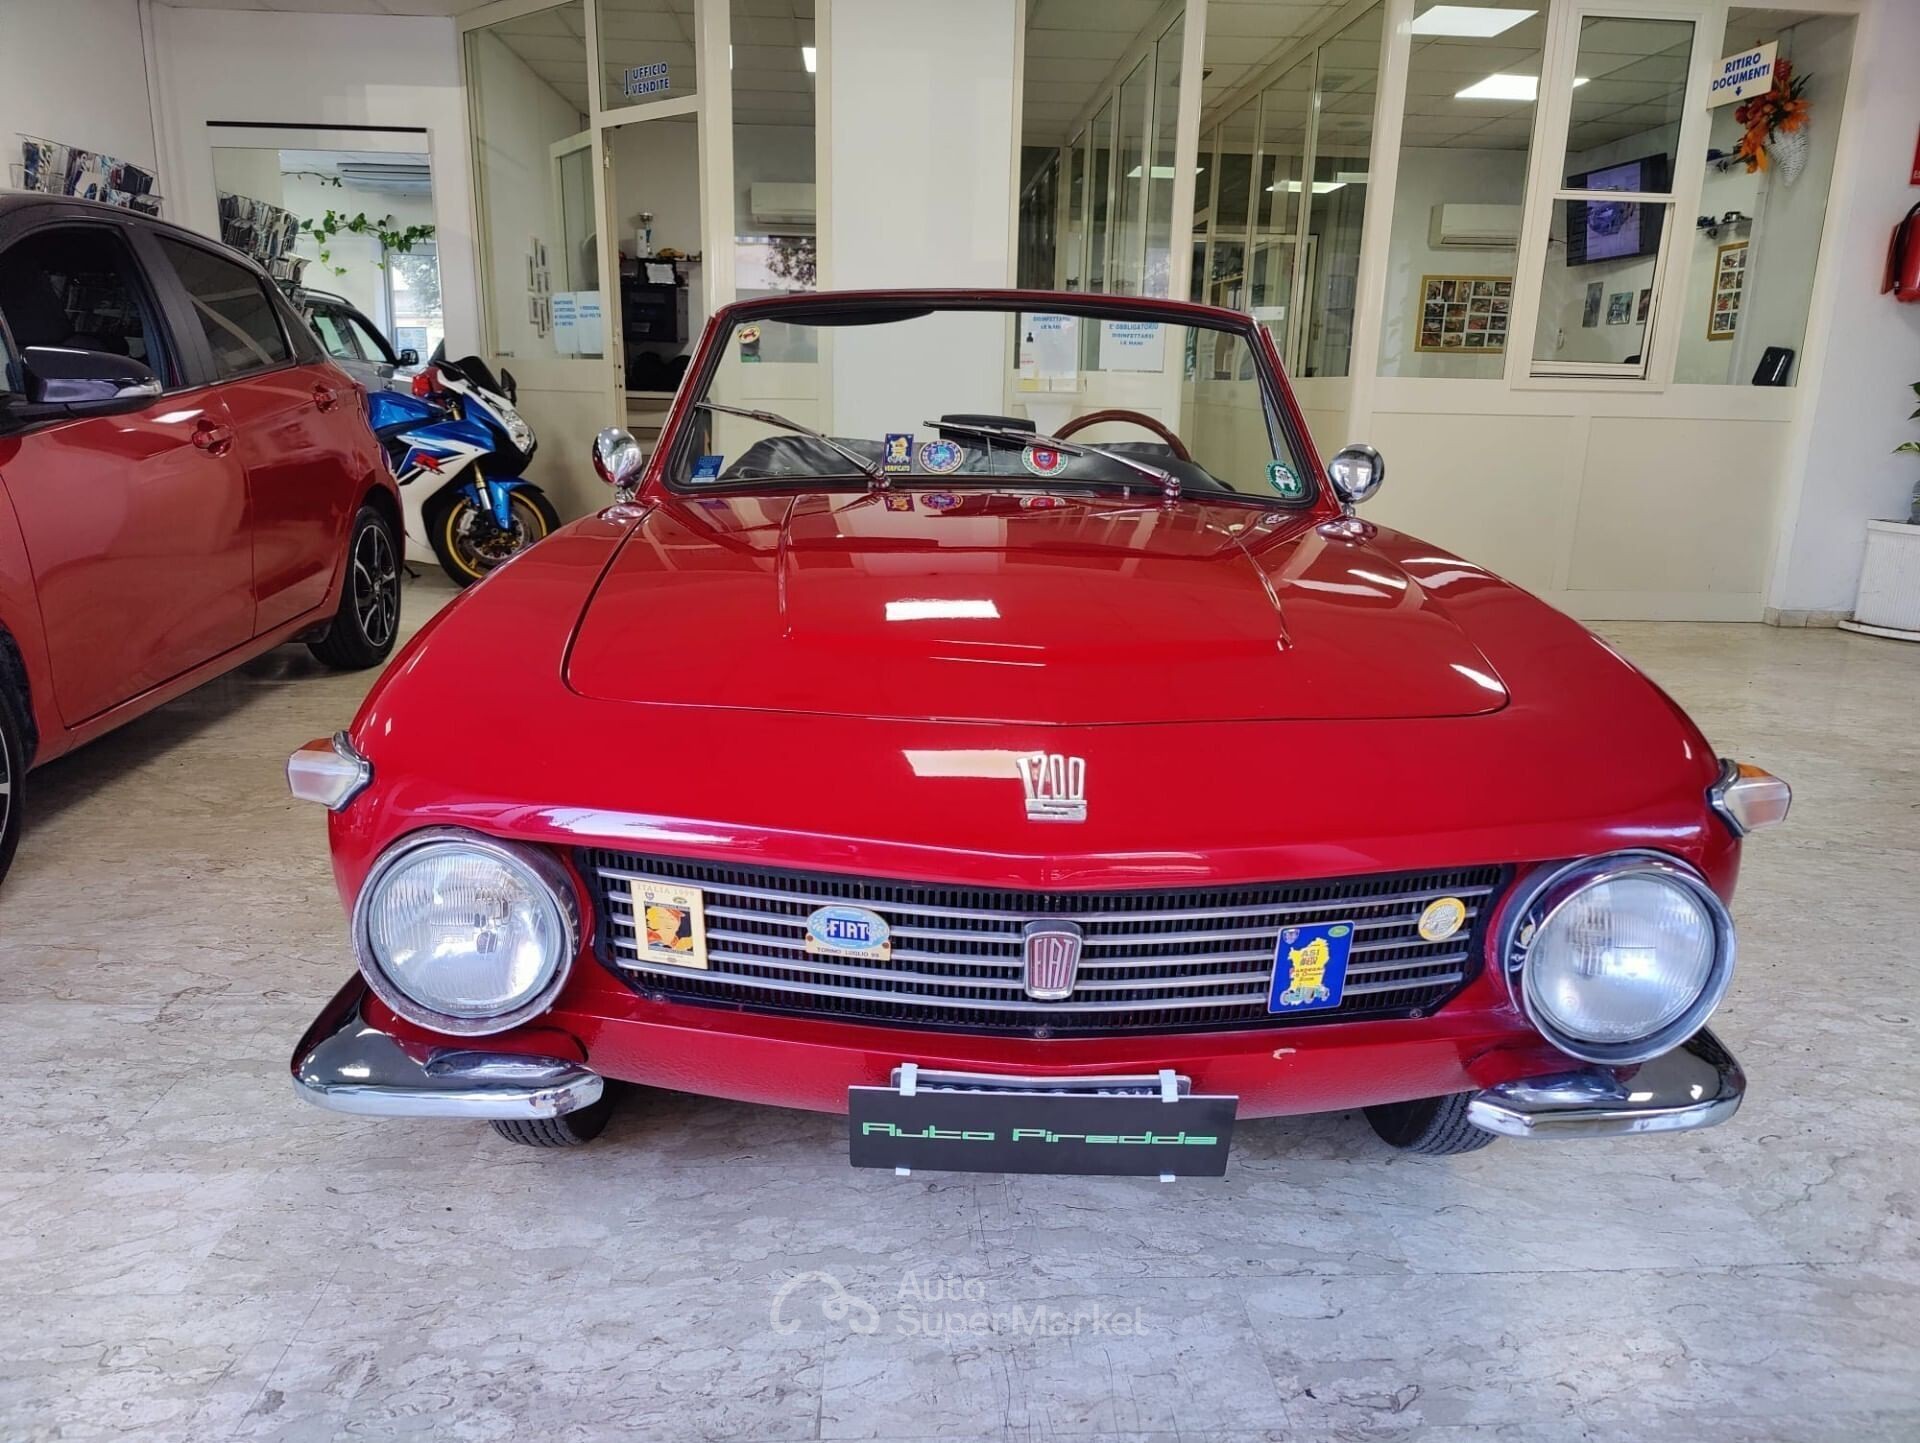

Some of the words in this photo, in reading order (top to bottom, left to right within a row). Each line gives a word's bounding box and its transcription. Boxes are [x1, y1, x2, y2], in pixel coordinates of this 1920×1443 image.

[632, 63, 667, 80] UFFICIO
[1725, 52, 1761, 73] RITIRO
[632, 78, 669, 94] VENDITE
[1712, 63, 1771, 91] DOCUMENTI
[829, 919, 869, 940] FIAT
[1034, 937, 1073, 989] FIAT
[862, 1121, 995, 1141] Auto
[1012, 1127, 1218, 1146] Piredda
